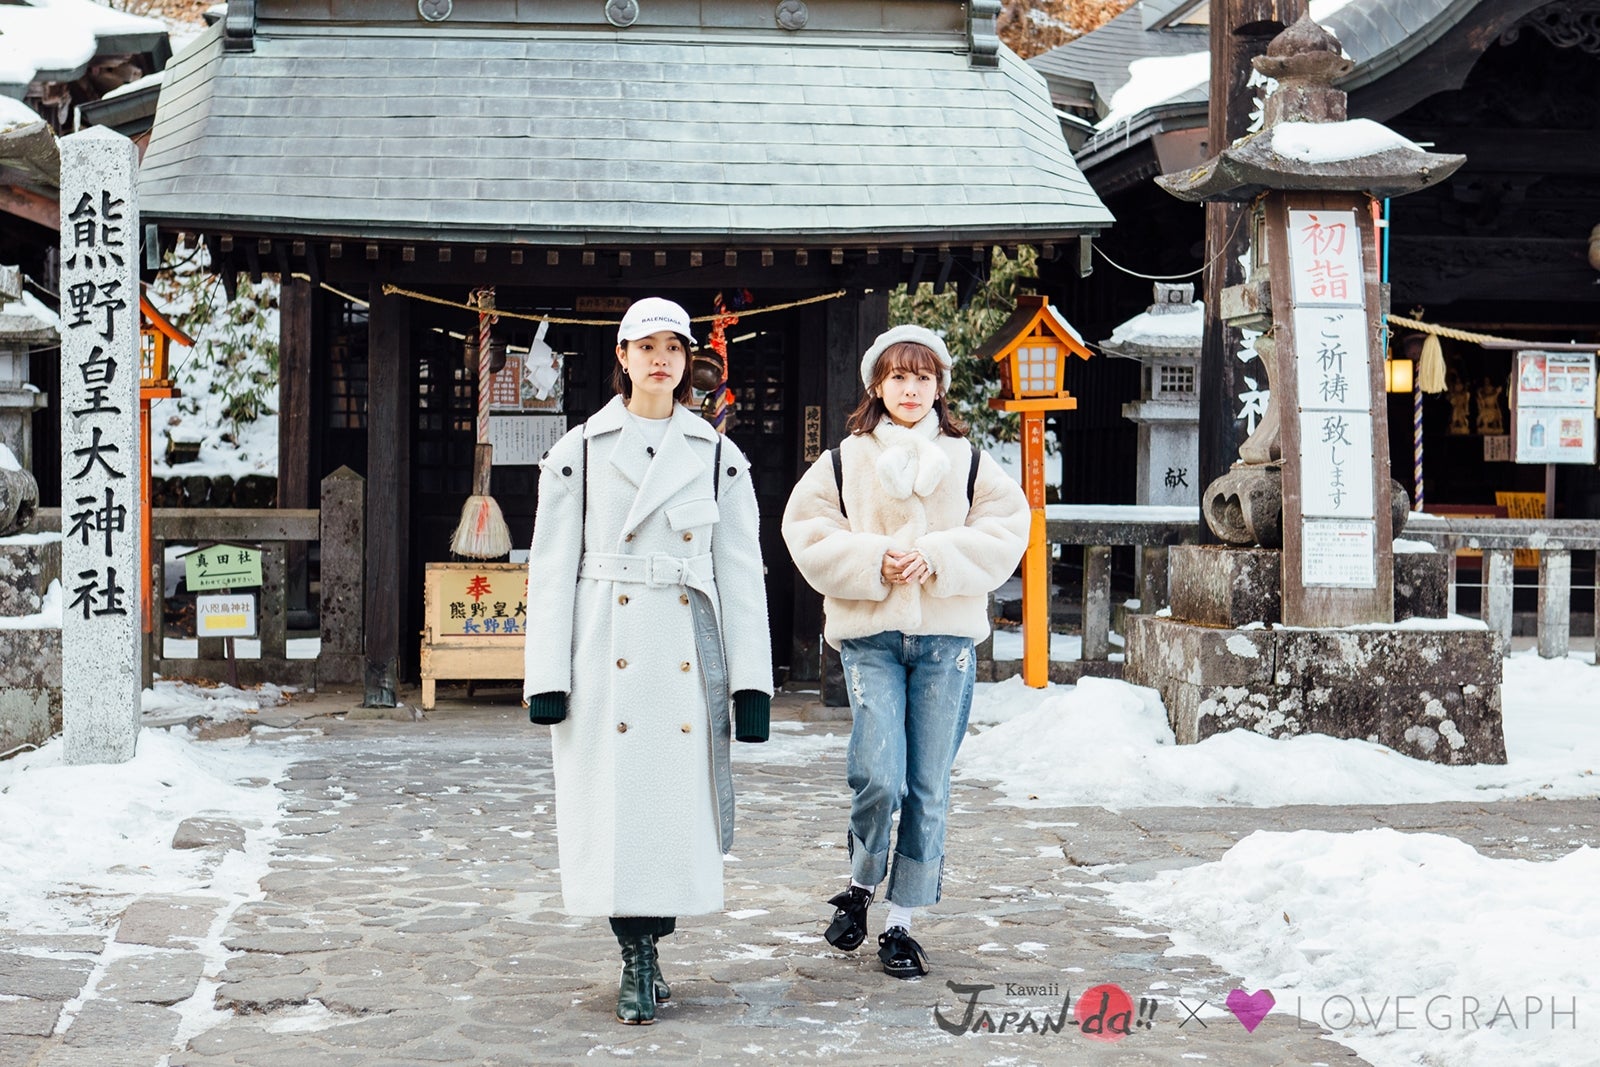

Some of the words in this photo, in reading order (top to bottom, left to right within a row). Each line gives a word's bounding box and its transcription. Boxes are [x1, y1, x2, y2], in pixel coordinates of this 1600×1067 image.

[1301, 213, 1349, 300] 初詣
[641, 316, 681, 325] BALENCIAGA
[1316, 314, 1348, 404] ご祈祷
[67, 190, 127, 620] 熊野皇大神社
[1164, 467, 1189, 489] 献
[1321, 415, 1352, 510] 致します
[196, 550, 252, 568] 真田社
[463, 617, 527, 634] 長野県
